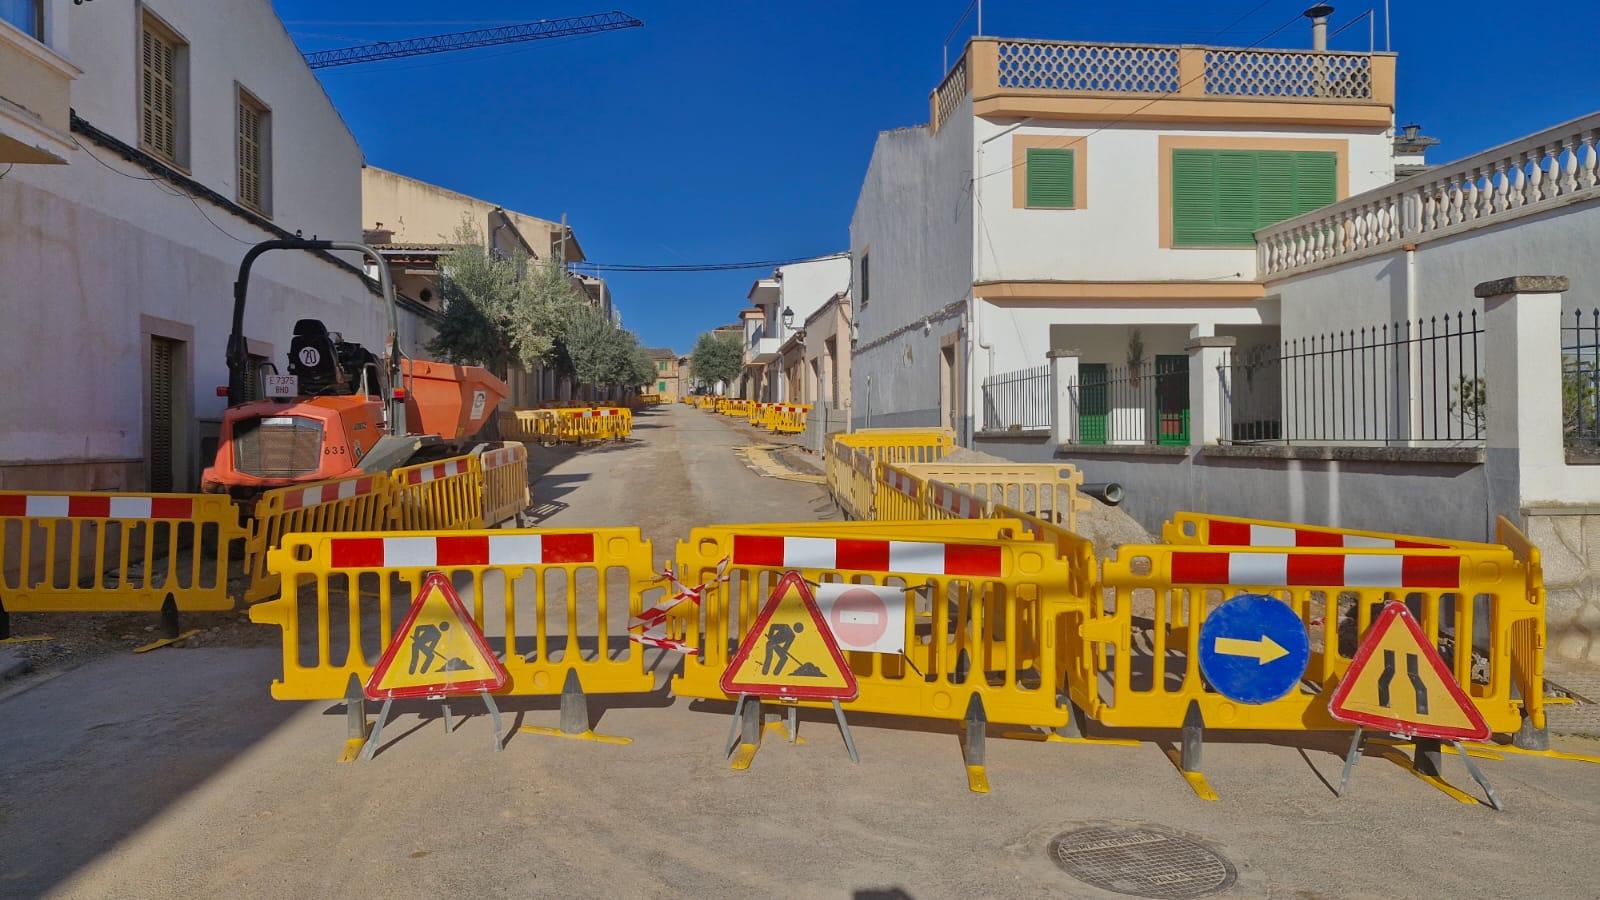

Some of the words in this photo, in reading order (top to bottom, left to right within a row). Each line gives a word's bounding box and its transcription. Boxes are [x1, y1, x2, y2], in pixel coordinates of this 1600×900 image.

[303, 349, 317, 364] 20
[276, 376, 295, 385] 7375
[324, 446, 345, 455] 635
